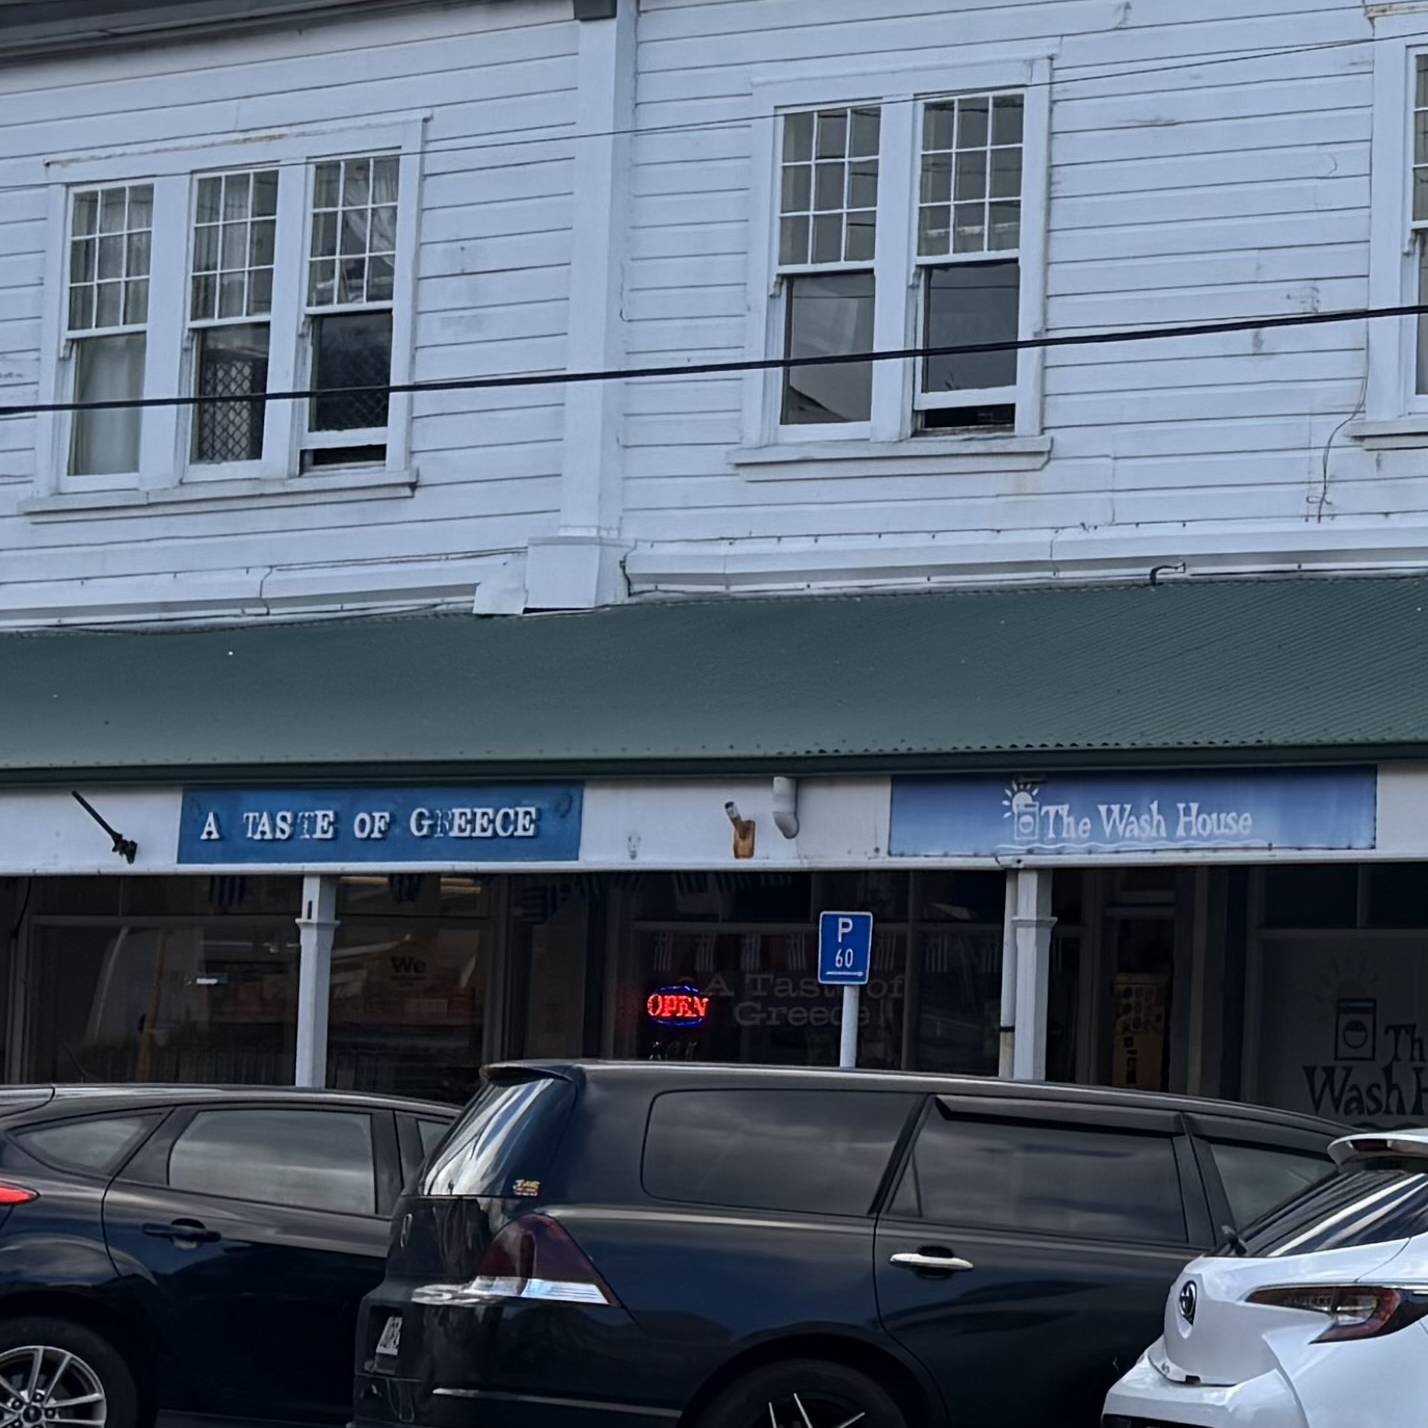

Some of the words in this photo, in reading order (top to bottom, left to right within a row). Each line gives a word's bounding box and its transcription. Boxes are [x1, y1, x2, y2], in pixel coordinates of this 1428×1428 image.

[200, 811, 221, 840] A
[243, 810, 336, 840] TASTE
[353, 811, 390, 839] OF
[409, 807, 537, 838] GREECE
[1041, 803, 1091, 839] The
[1097, 801, 1167, 839] Wash
[1175, 802, 1253, 837] House
[837, 918, 854, 943] P
[390, 956, 426, 977] We
[834, 948, 854, 968] 60
[704, 975, 733, 996] A
[866, 974, 905, 999] of
[646, 994, 709, 1018] OPEN
[1302, 1064, 1404, 1116] Wash
